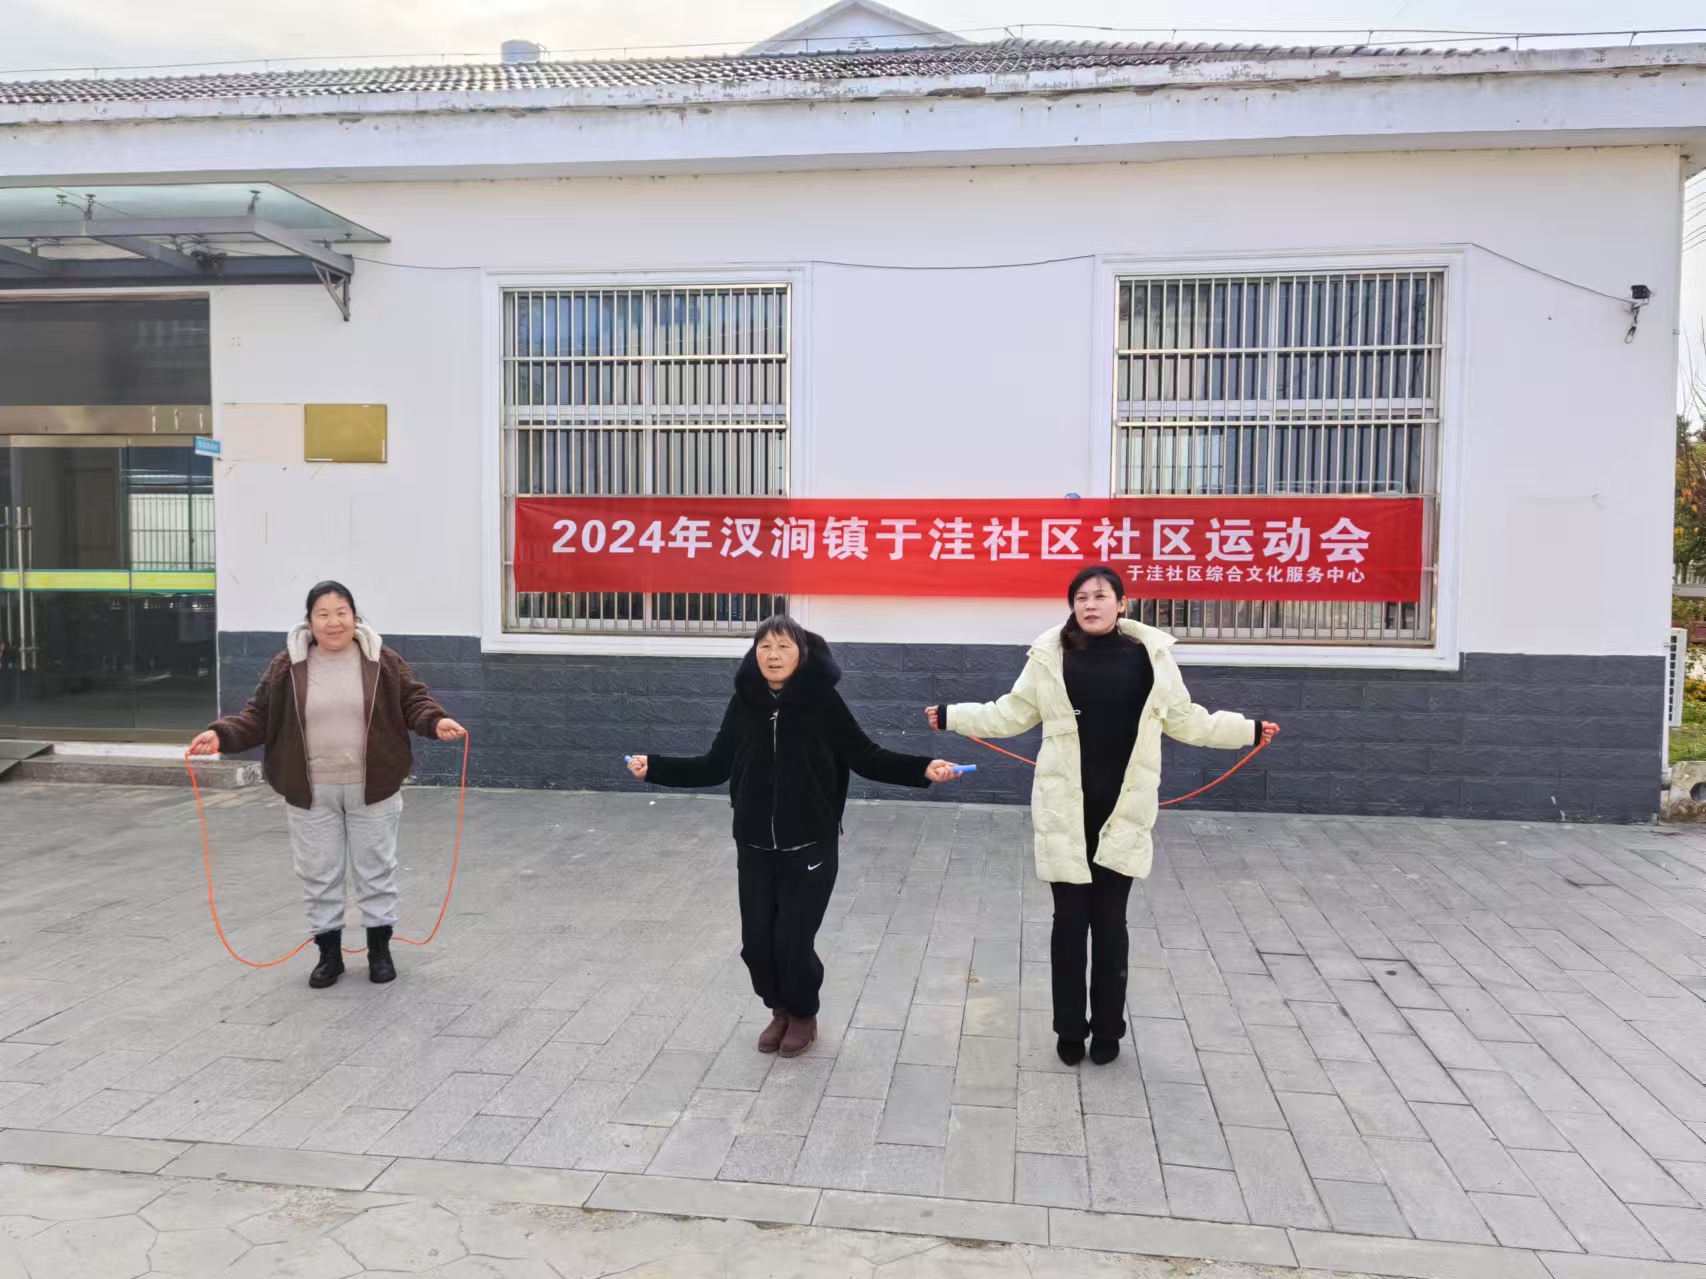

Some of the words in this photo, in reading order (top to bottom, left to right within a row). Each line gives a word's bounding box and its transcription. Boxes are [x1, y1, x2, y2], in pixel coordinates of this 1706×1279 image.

[552, 516, 1371, 563] 2024年汊涧镇于洼社区社区运动会
[1126, 565, 1366, 584] 于洼社区综合文化服务中心
